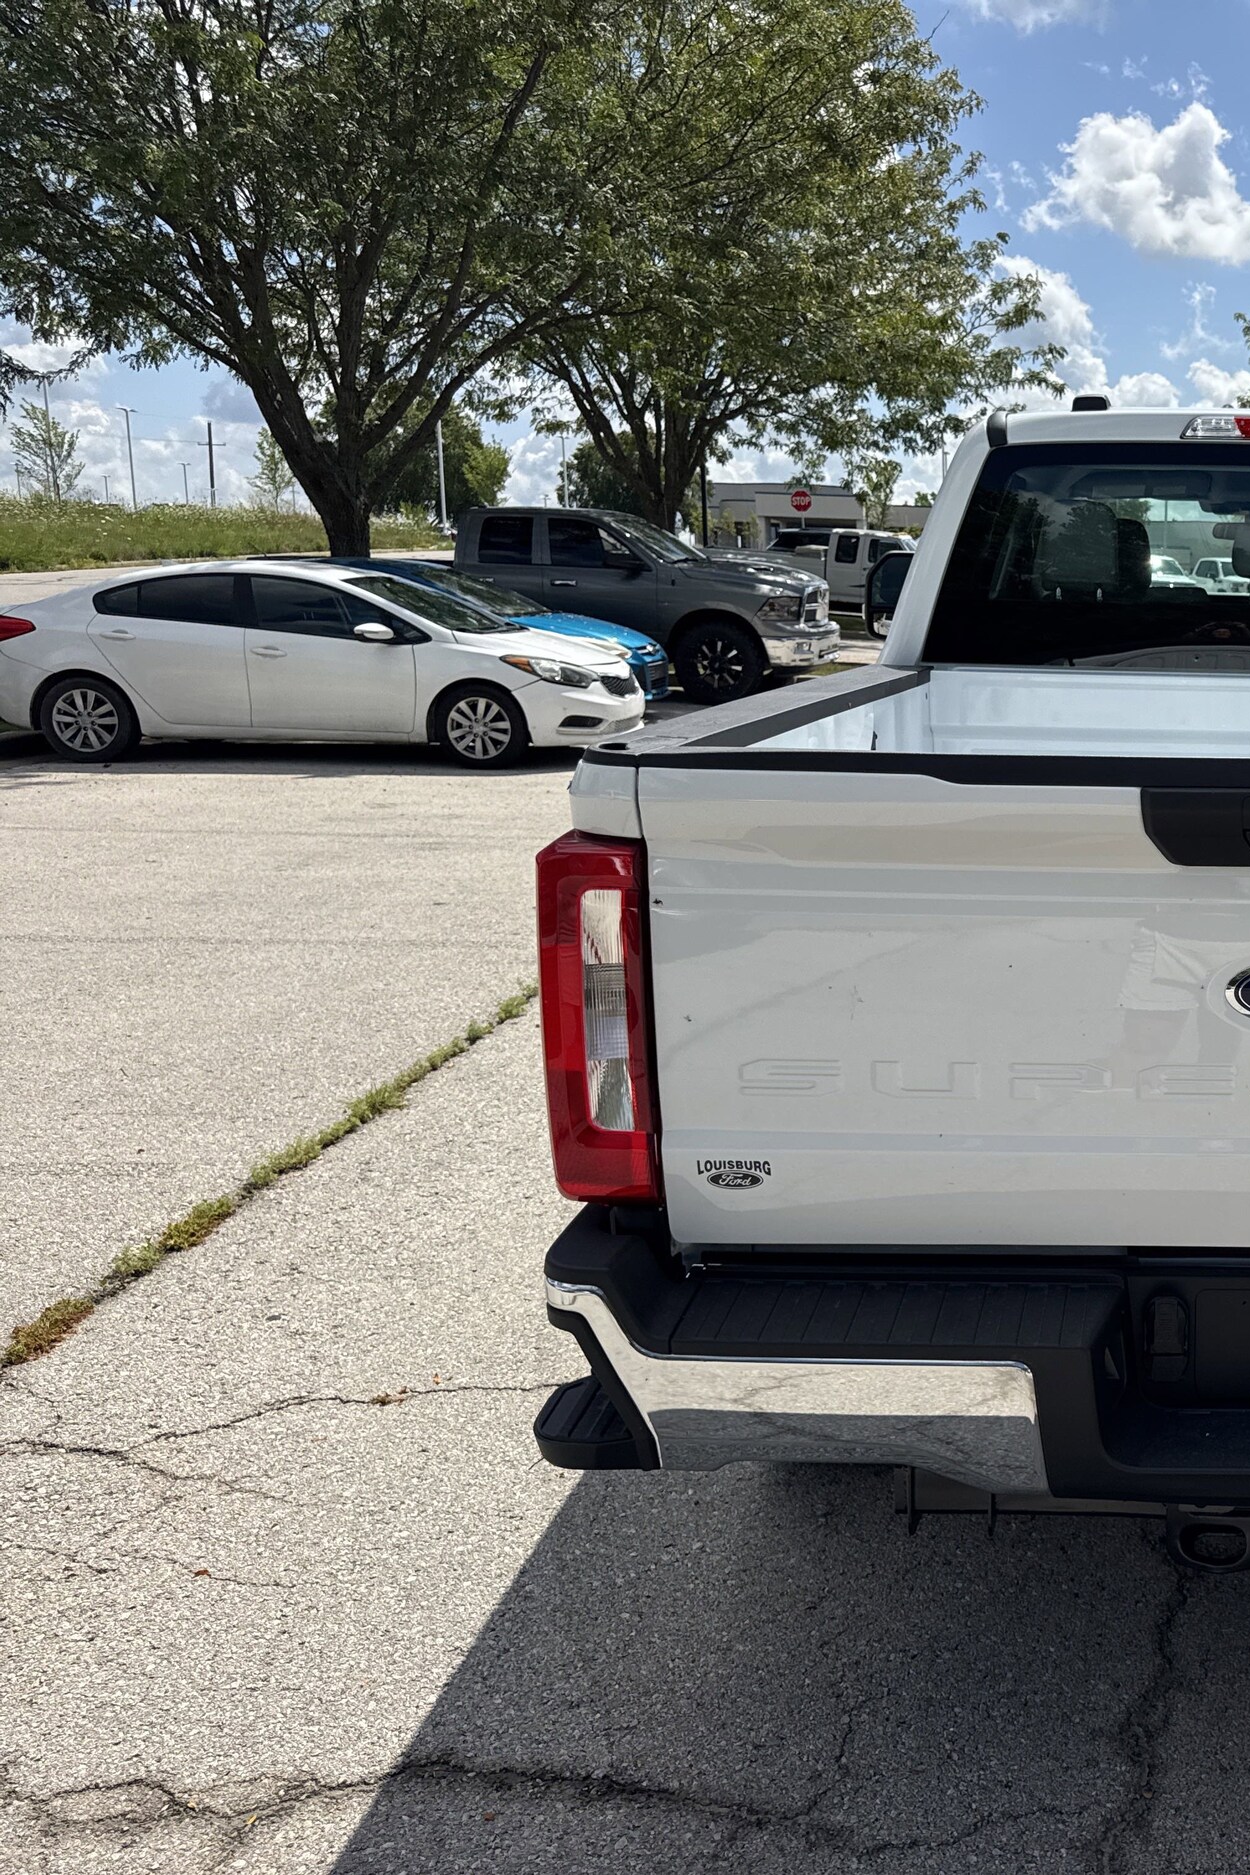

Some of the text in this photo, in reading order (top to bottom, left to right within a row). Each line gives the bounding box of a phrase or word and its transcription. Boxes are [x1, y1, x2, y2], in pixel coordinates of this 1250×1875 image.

[792, 496, 811, 506] STOP
[696, 1160, 771, 1176] LOUISBURG
[719, 1173, 752, 1186] Ford
